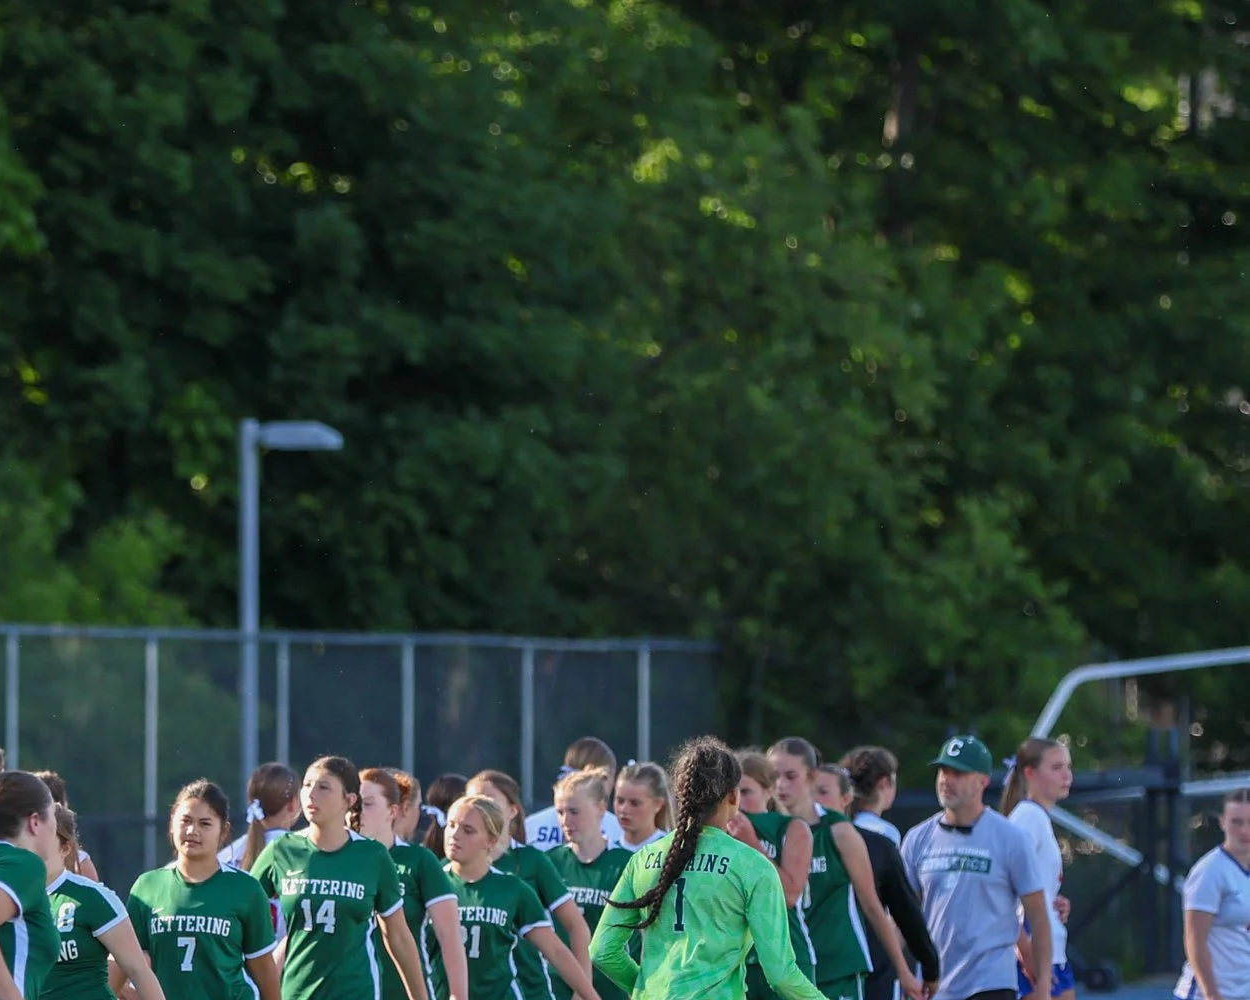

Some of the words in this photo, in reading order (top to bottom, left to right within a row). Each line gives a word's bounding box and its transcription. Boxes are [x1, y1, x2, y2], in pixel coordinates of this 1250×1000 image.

[947, 739, 964, 757] C
[537, 826, 560, 843] SA
[645, 851, 729, 875] CAAINS
[281, 878, 365, 900] KETTERING
[301, 899, 337, 933] 14
[457, 906, 508, 926] TERING
[674, 877, 686, 932] 1
[56, 902, 76, 932] 8
[151, 916, 231, 937] KETTERING
[177, 937, 196, 972] 7
